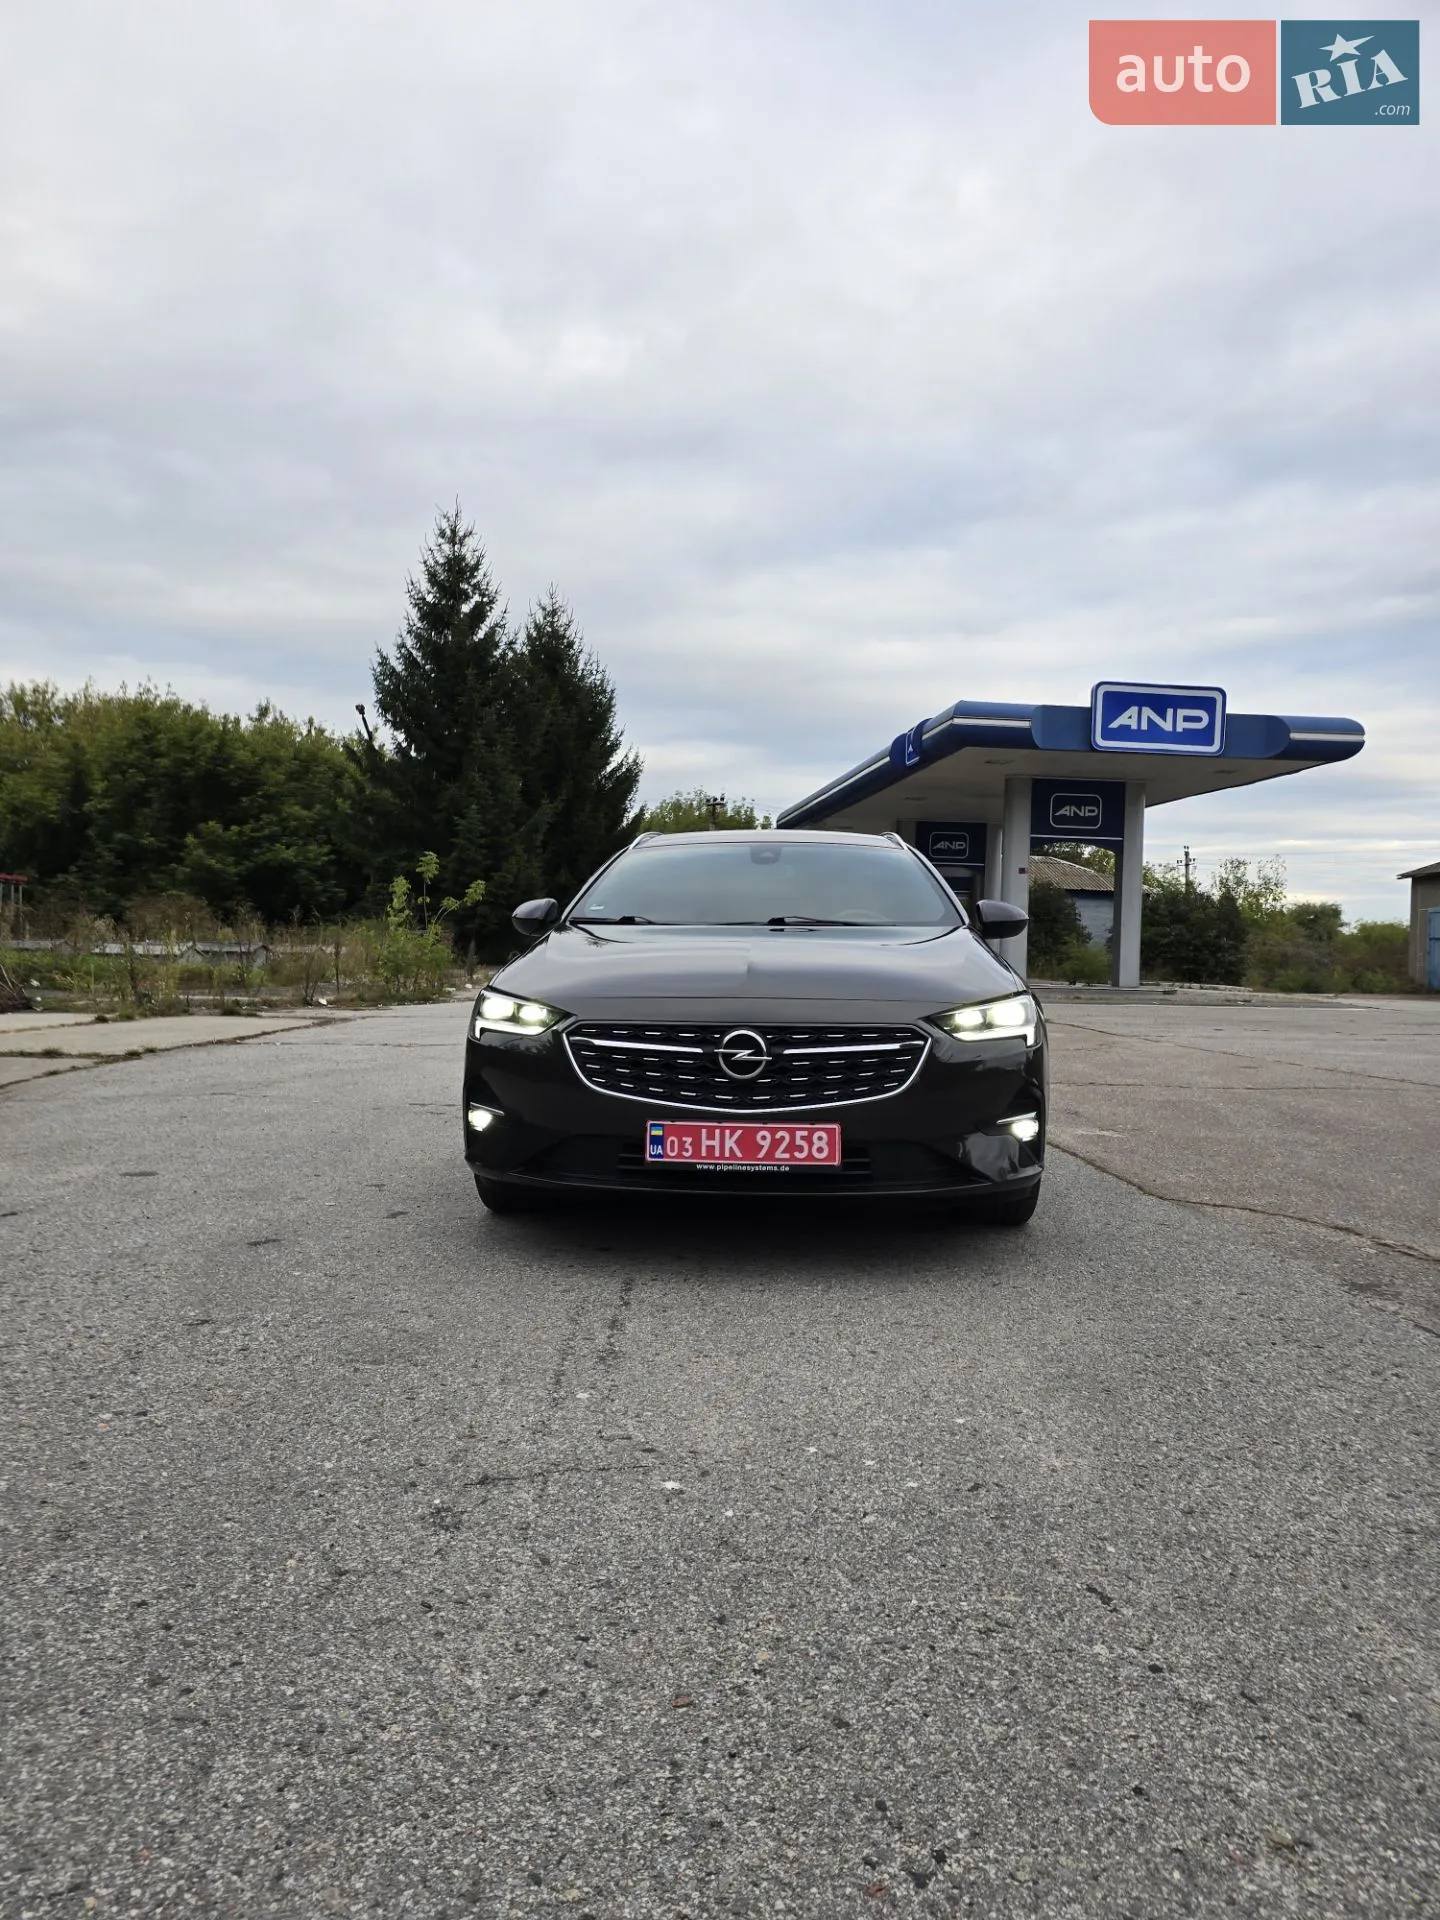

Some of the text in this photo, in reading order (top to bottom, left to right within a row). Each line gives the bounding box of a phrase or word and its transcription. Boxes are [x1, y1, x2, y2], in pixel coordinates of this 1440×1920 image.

[1107, 705, 1210, 733] ANP
[1054, 805, 1099, 817] ANP
[932, 840, 966, 850] ANP
[649, 1143, 663, 1156] UA
[666, 1128, 829, 1160] 03 HK 9258
[695, 1163, 790, 1172] www.pipelinesystems.de
